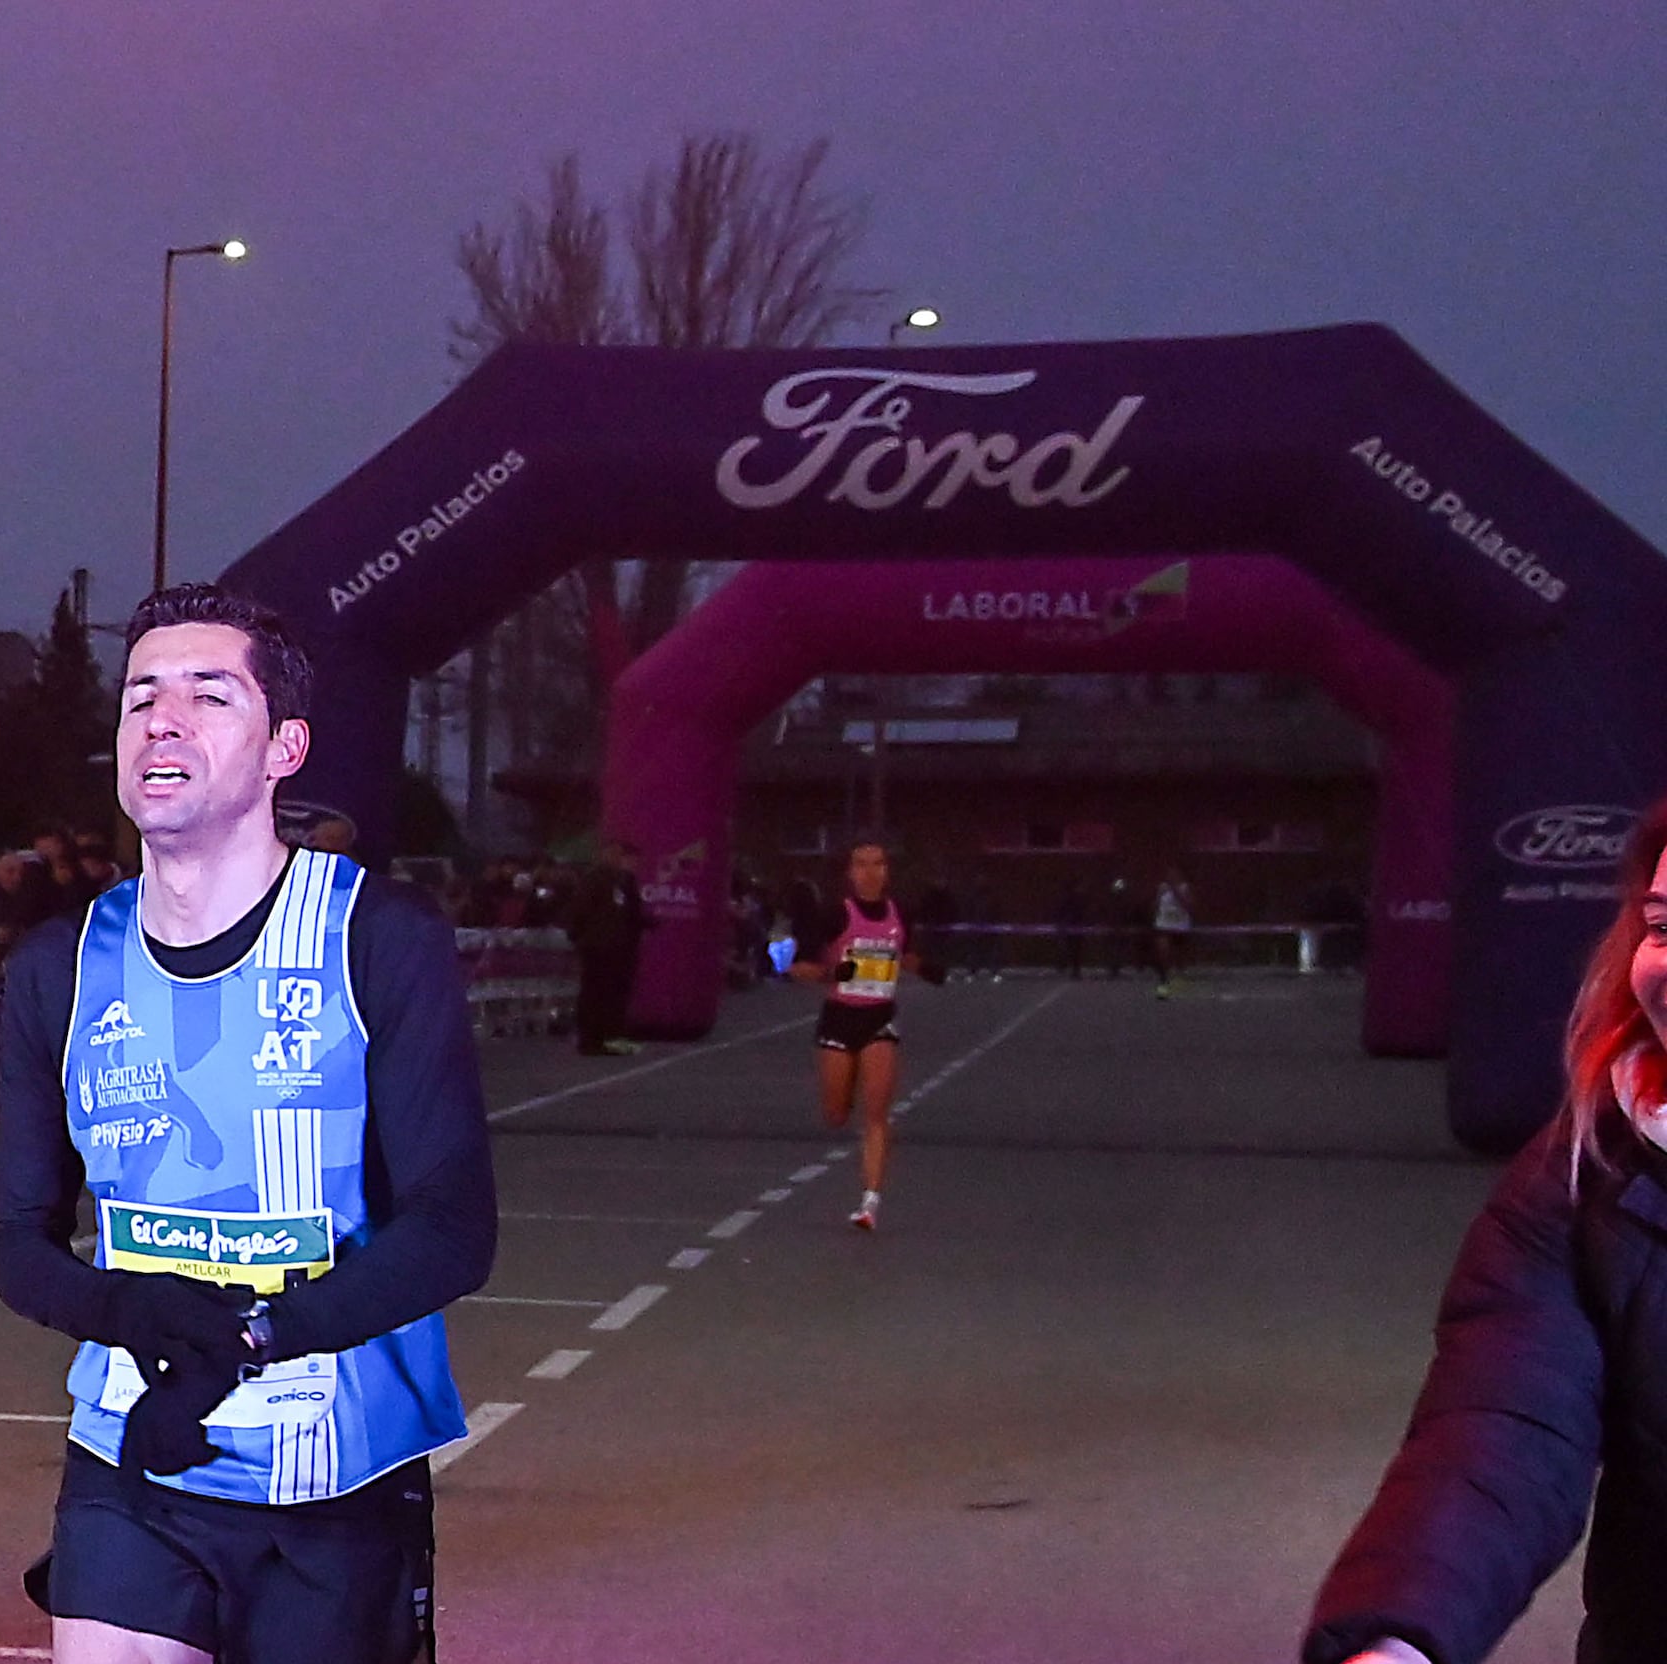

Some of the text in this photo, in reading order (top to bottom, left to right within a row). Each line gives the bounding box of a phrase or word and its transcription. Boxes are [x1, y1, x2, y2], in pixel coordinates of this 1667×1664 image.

[715, 367, 1145, 511] Ford
[328, 449, 527, 614] Auto Palacios
[1349, 435, 1567, 603] Auto Palacios
[923, 590, 1100, 620] LABORAL
[95, 1058, 167, 1090] AGRITRASA
[130, 1214, 299, 1264] El Corte Inglés
[175, 1260, 232, 1279] AMILCAR
